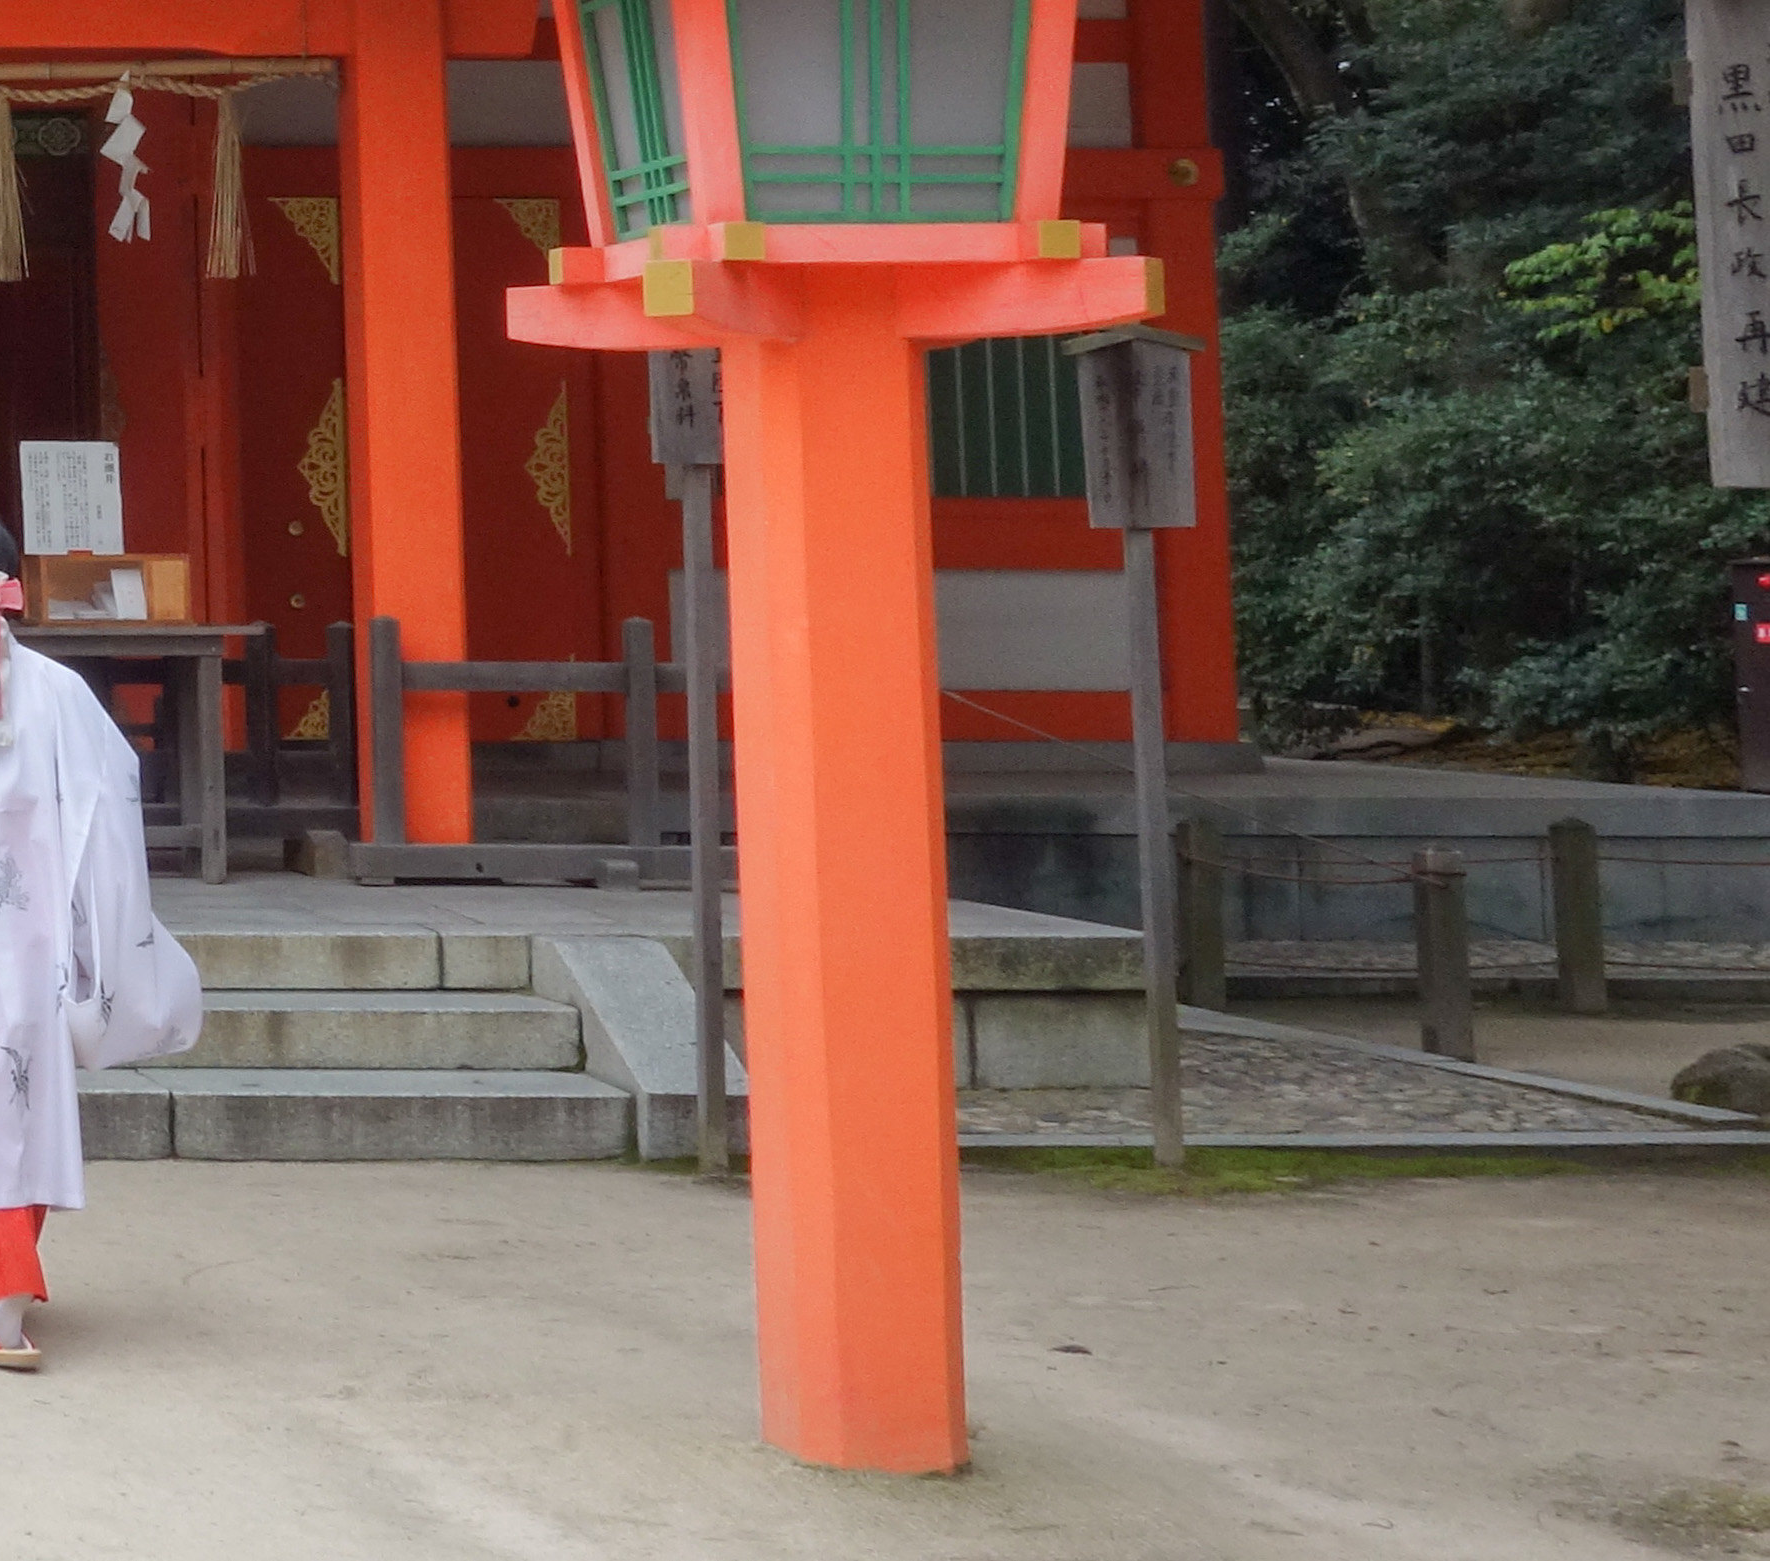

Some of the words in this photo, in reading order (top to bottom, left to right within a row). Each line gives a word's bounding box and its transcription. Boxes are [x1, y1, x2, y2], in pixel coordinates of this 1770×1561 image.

[1718, 63, 1770, 416] 黒田長政再建
